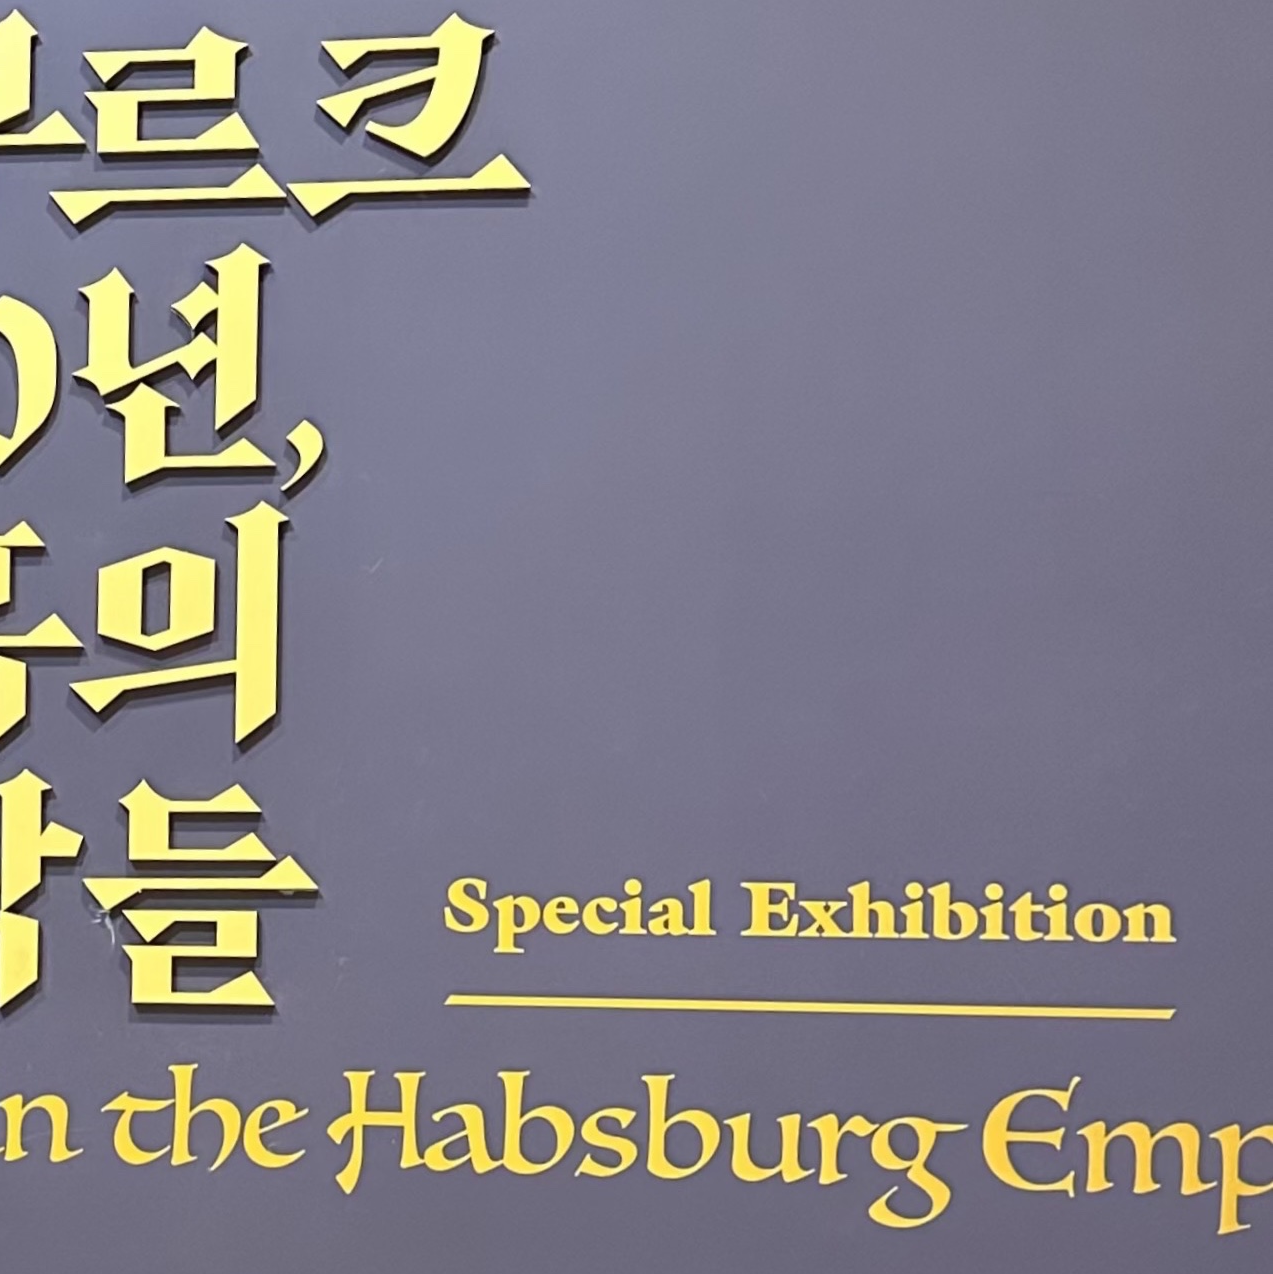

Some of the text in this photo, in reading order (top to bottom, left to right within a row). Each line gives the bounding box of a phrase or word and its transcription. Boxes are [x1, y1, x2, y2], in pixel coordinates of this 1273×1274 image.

[443, 877, 1177, 954] Special Exhibition
[100, 1063, 310, 1172] the
[326, 1070, 970, 1229] Habsburg
